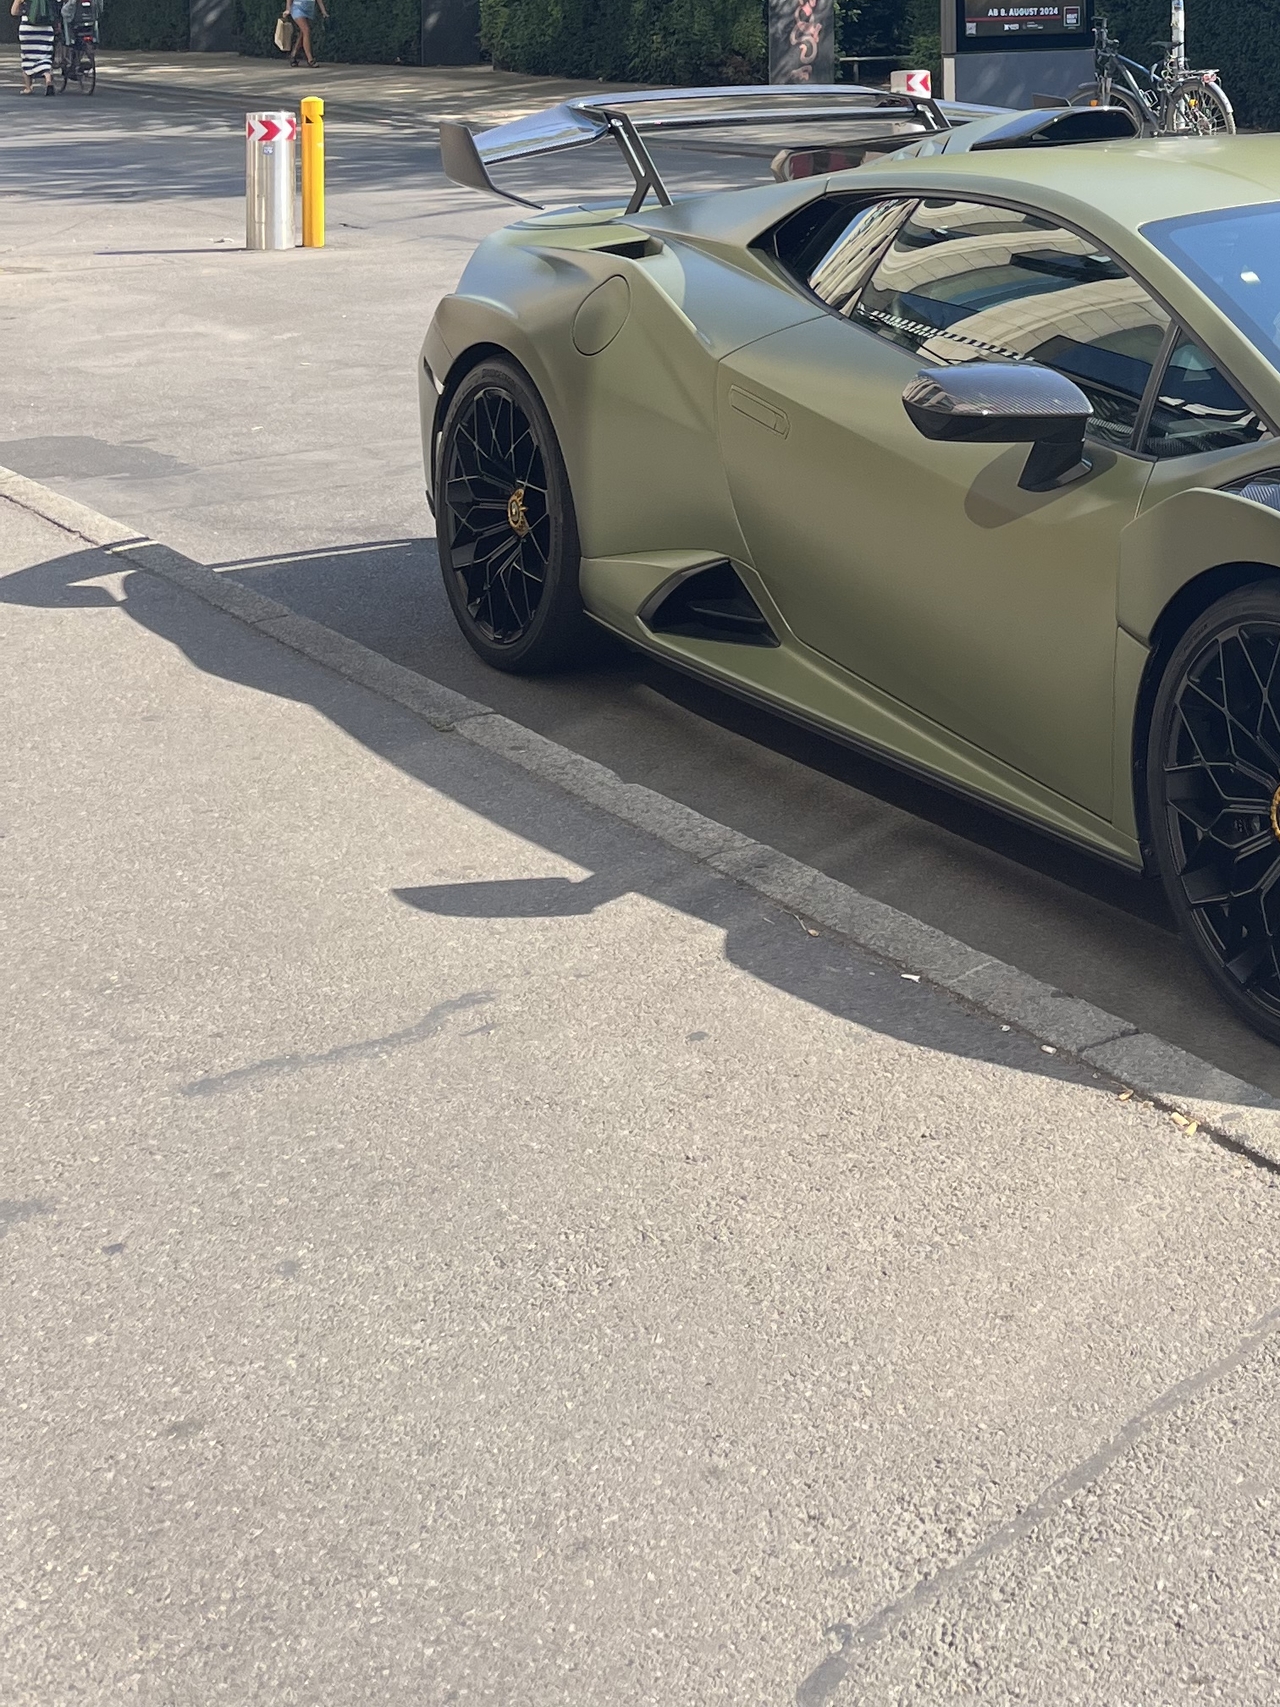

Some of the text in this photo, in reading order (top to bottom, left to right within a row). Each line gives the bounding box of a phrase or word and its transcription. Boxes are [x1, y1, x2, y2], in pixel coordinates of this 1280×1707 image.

[988, 8, 998, 16] AB
[1009, 8, 1038, 16] AUGUST
[1040, 7, 1058, 15] 2024
